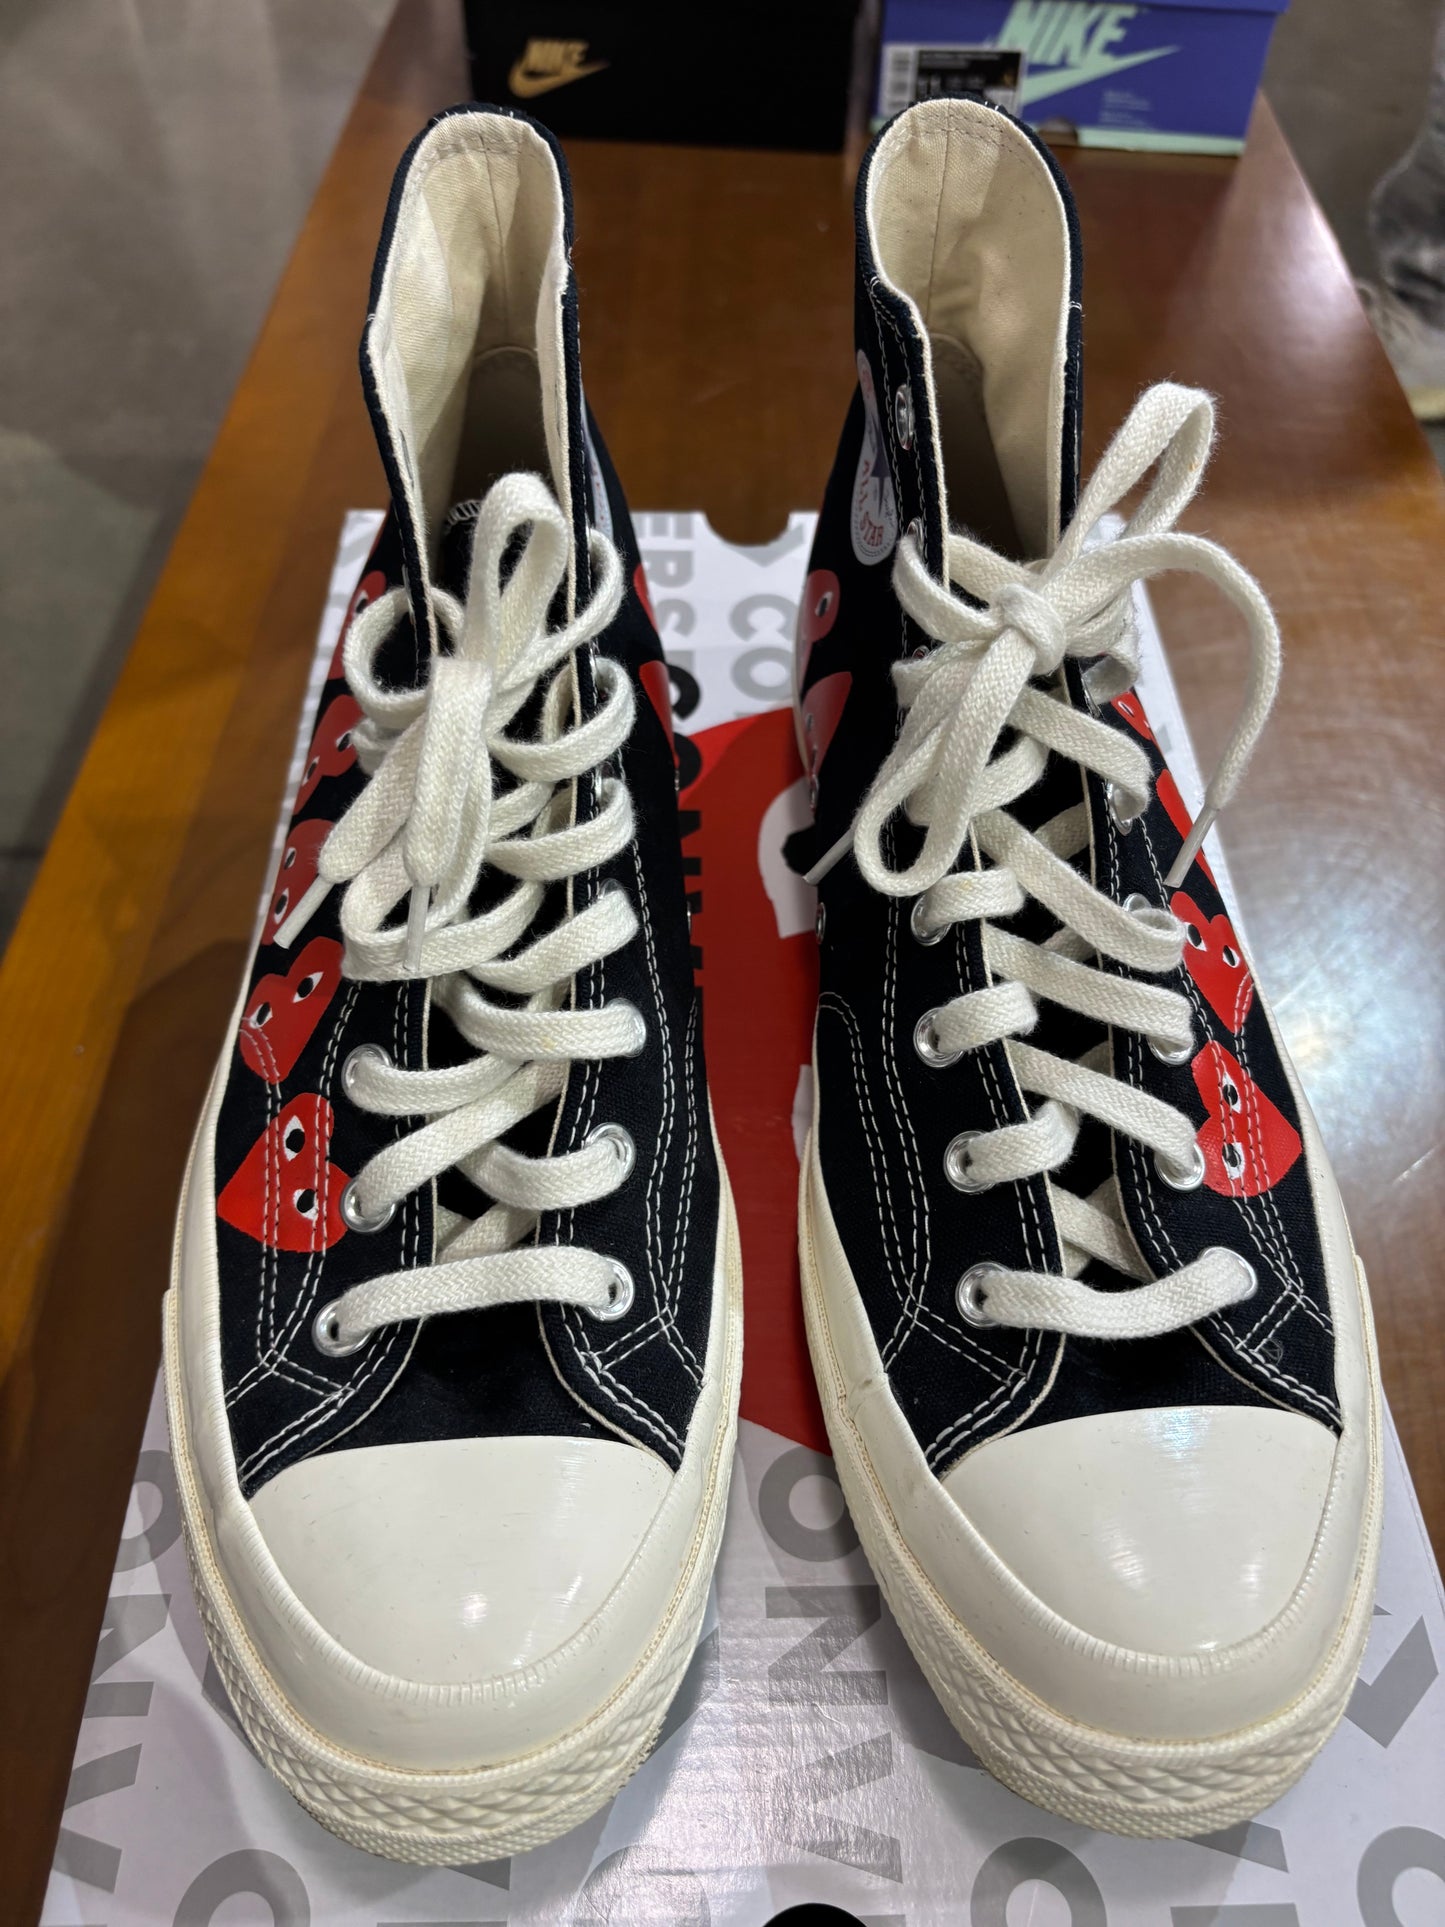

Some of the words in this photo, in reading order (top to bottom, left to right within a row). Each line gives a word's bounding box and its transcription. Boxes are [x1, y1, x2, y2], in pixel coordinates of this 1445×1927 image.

[526, 38, 589, 71] NIKE
[997, 0, 1138, 66] NIKE
[861, 511, 884, 547] STAR
[730, 593, 799, 718] CO
[757, 1446, 906, 1927] ONV
